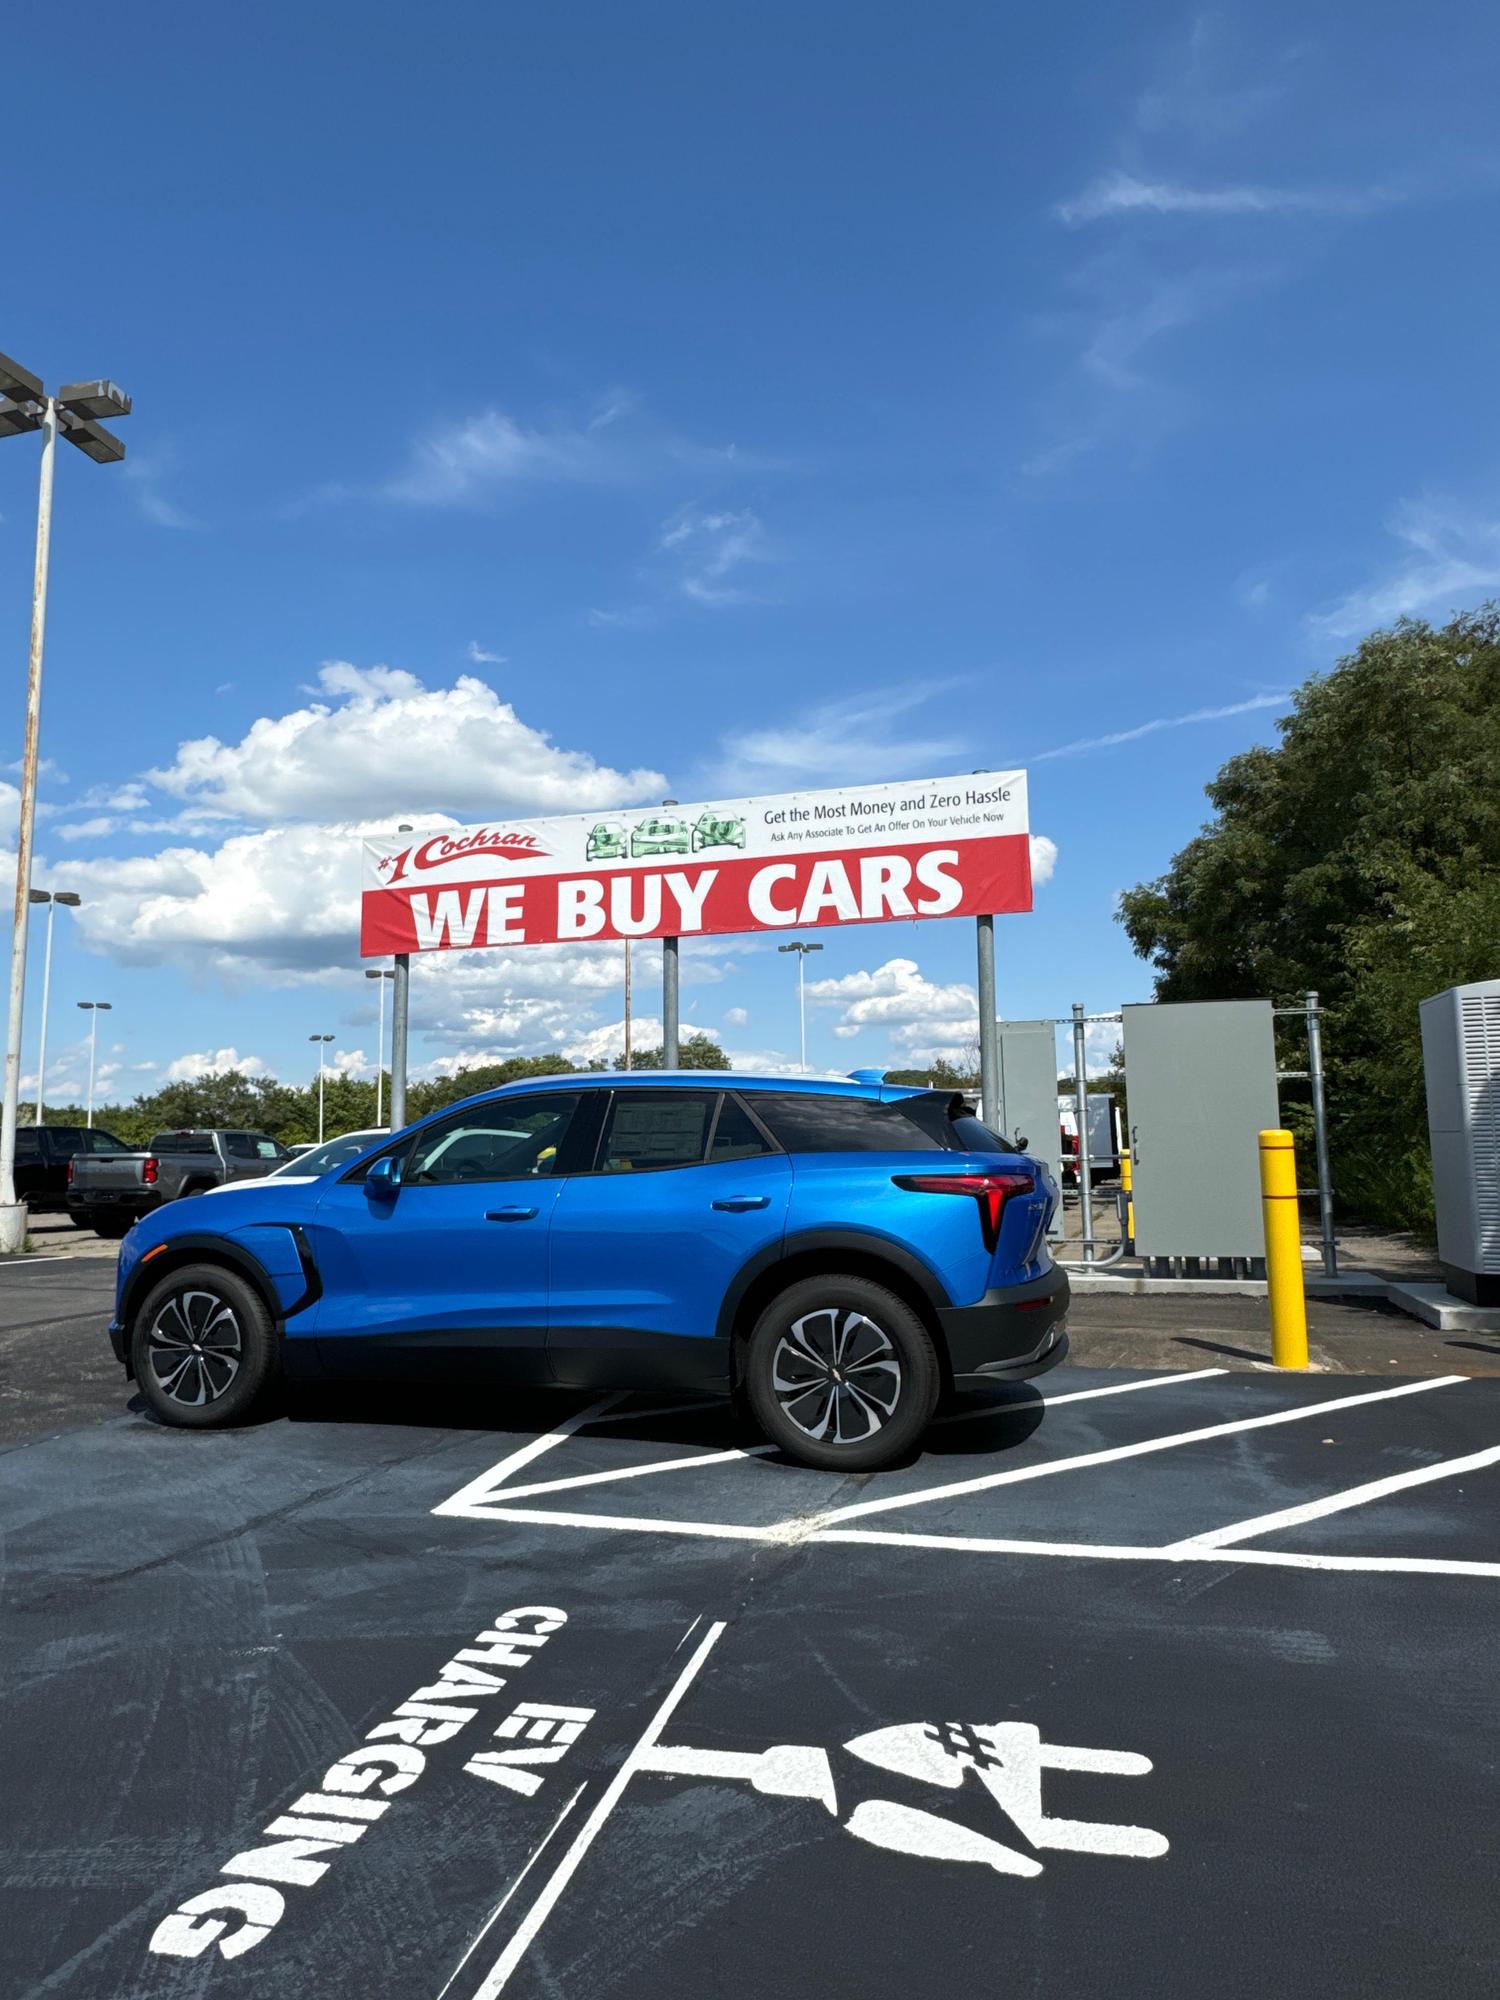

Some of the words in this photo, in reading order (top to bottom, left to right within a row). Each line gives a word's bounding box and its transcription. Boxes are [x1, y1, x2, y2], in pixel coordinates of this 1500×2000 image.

[764, 810, 786, 825] Get
[789, 807, 810, 822] the
[814, 804, 846, 820] Most
[850, 801, 896, 816] Money
[900, 795, 925, 812] and
[929, 794, 961, 809] Zero
[965, 787, 1011, 805] Hassle
[770, 832, 785, 842] Ask
[787, 831, 803, 841] Any
[805, 827, 843, 839] Associate
[846, 825, 855, 835] To
[857, 824, 872, 834] Get
[874, 823, 886, 832] An
[888, 821, 910, 832] Offer
[912, 819, 925, 829] On
[927, 817, 948, 828] Your
[949, 814, 981, 826] Vehicle
[983, 813, 1004, 822] Now
[376, 845, 413, 886] #1
[413, 827, 554, 870] Cochran
[410, 884, 526, 950] WE
[557, 868, 719, 939] BUY
[748, 849, 963, 926] CARS
[148, 1606, 568, 1960] CHARGING
[462, 1702, 597, 1797] EV
